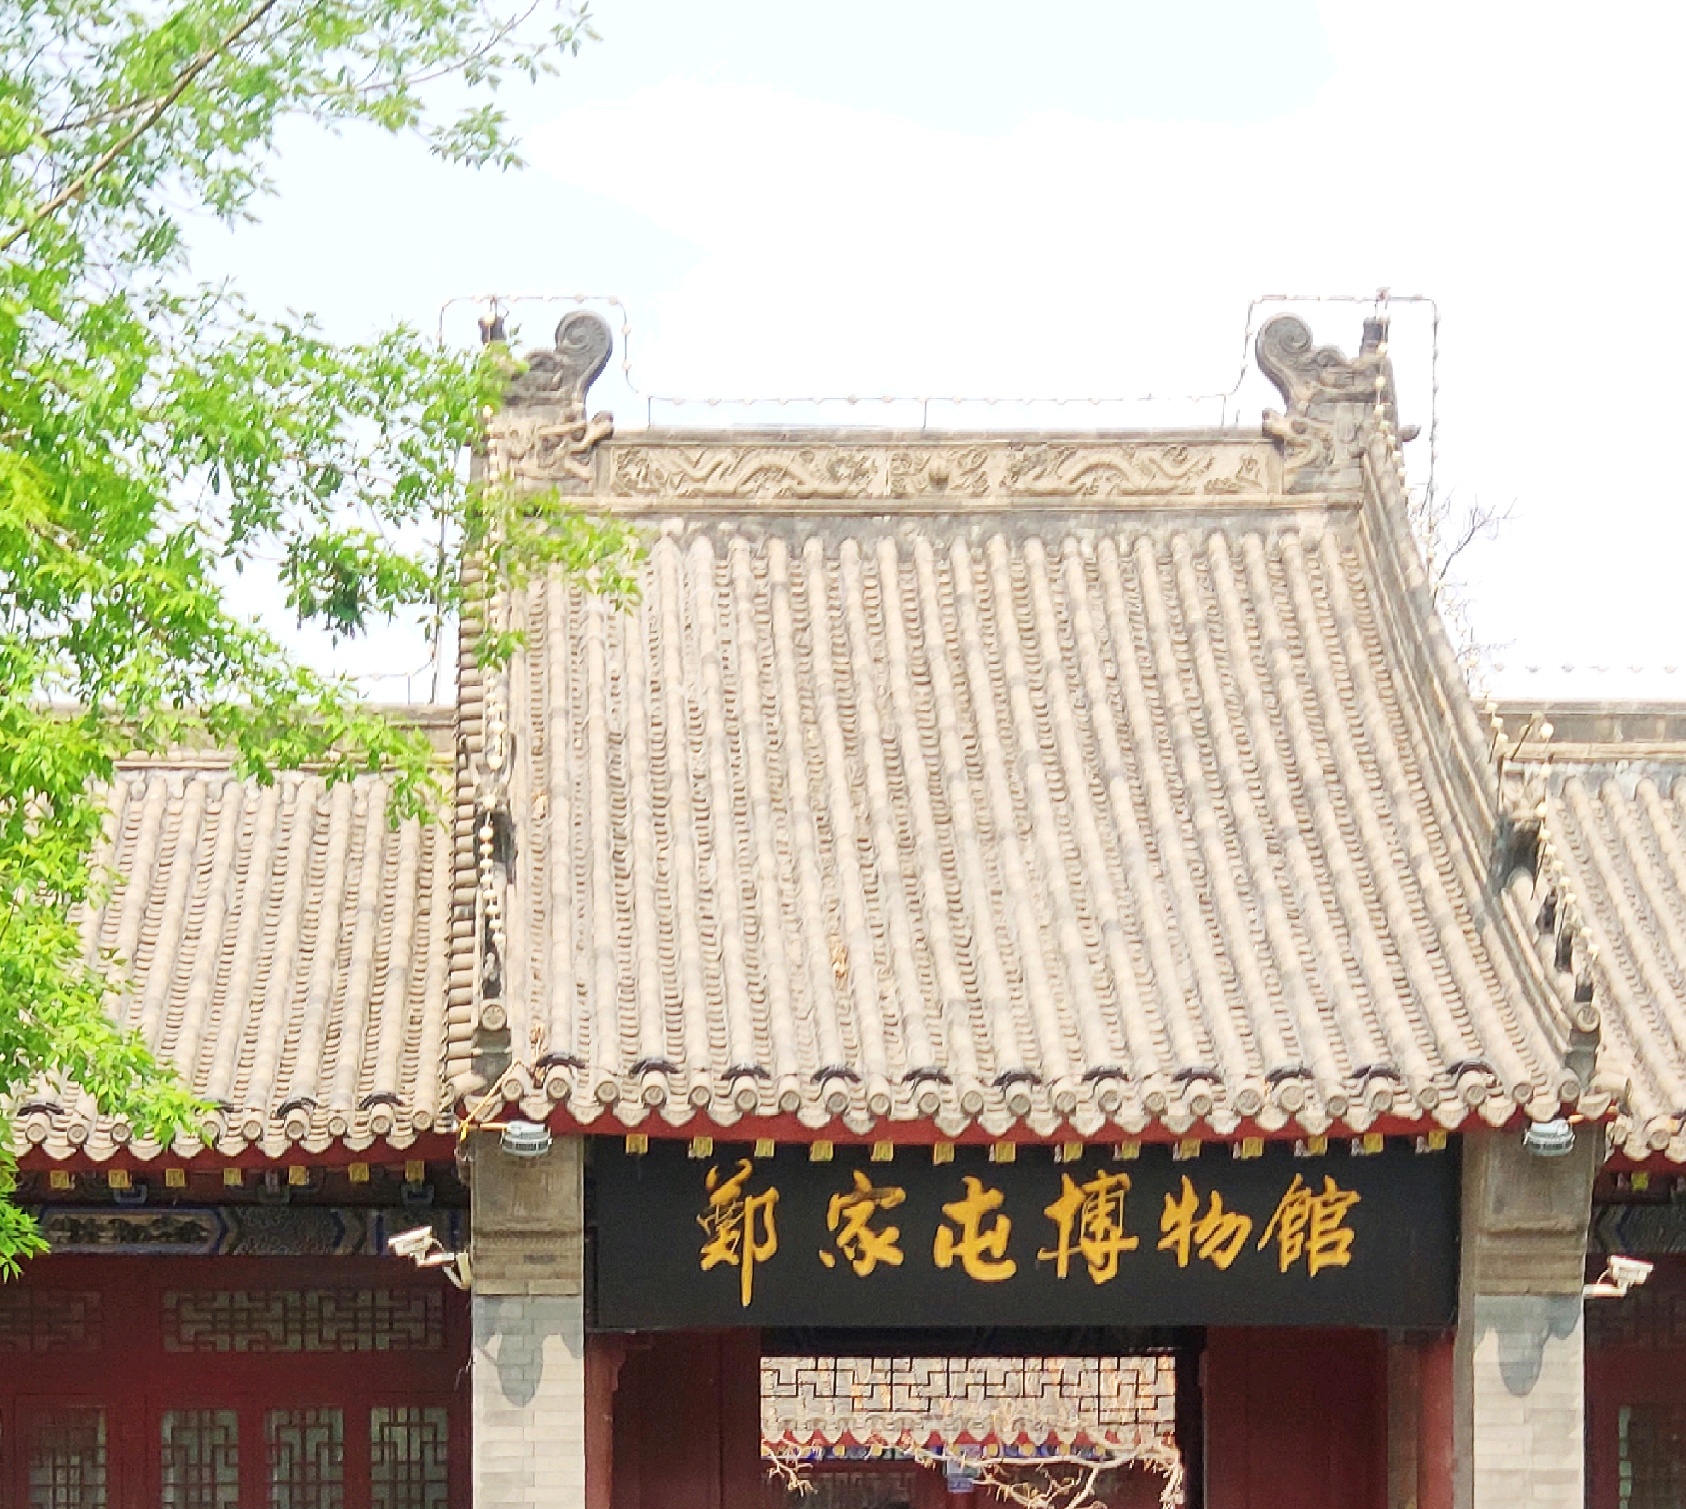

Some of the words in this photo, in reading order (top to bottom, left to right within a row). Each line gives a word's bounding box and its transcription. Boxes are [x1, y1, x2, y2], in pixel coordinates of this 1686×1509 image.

[697, 1158, 1362, 1307] 鄭家屯博物館
